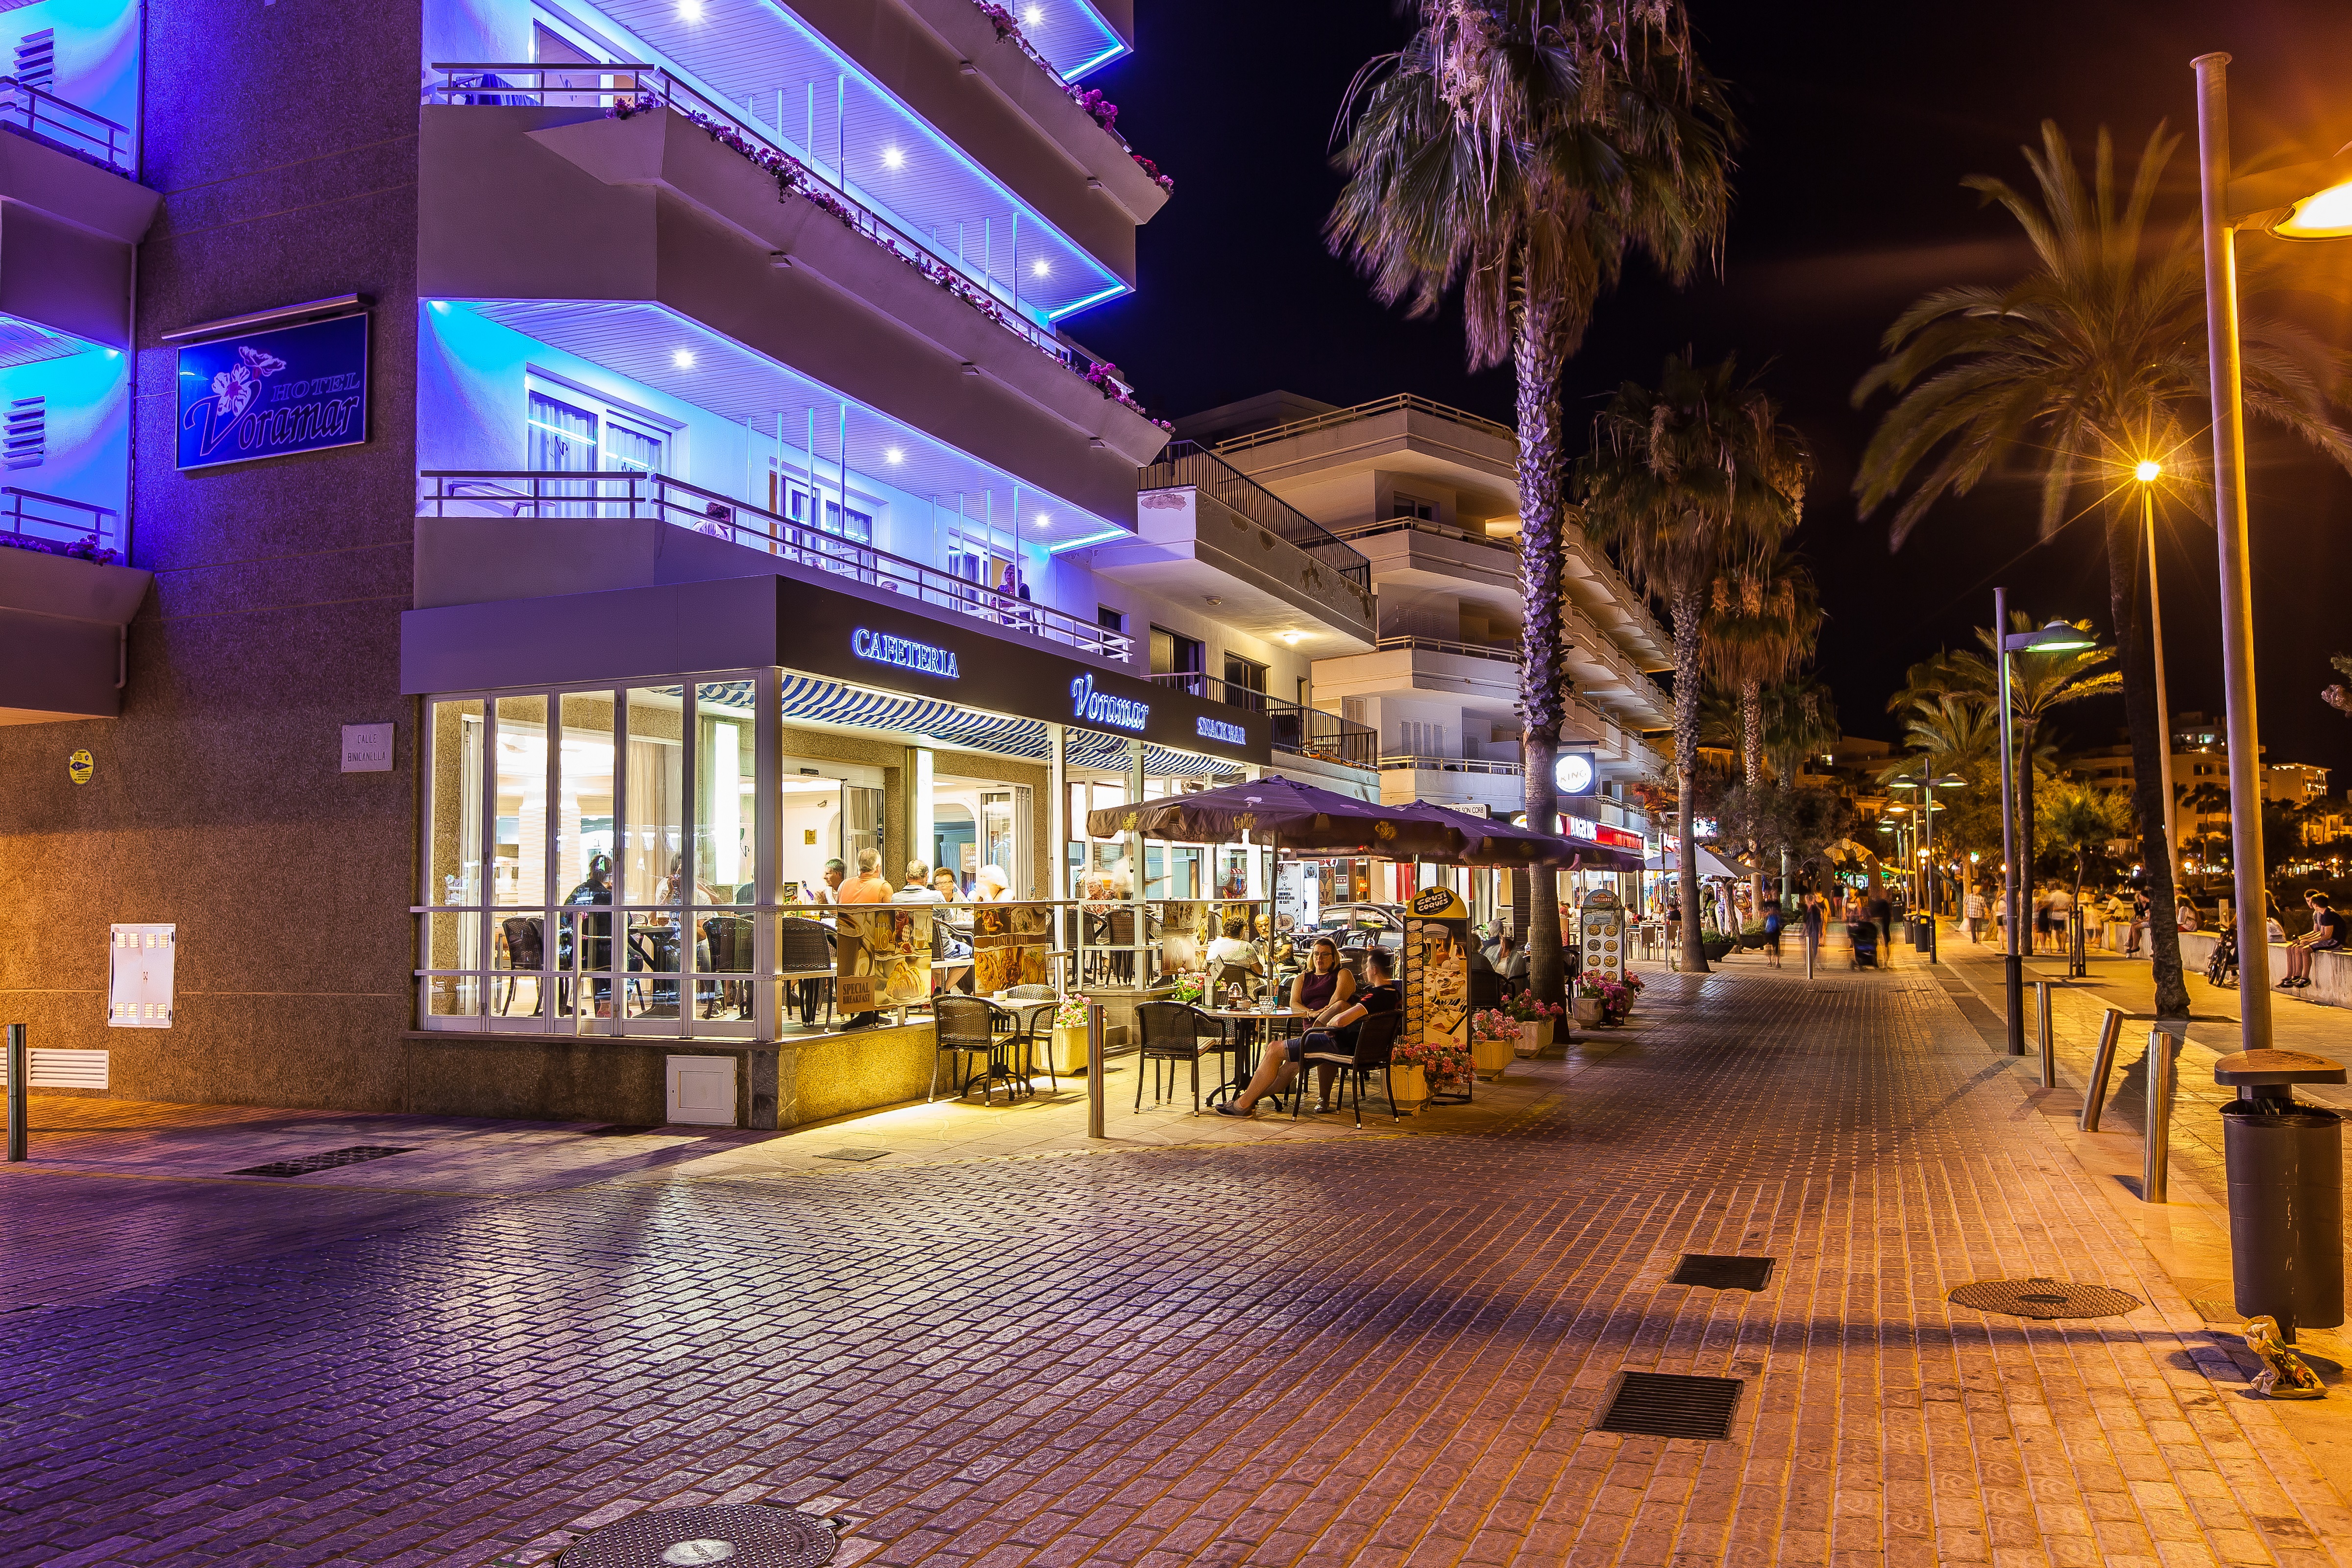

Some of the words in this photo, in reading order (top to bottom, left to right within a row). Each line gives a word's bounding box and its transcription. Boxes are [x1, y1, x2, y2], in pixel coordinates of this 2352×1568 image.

[271, 372, 360, 402] HOTEL
[183, 379, 360, 456] Voramar
[855, 629, 960, 678] CAFETERIA
[1071, 674, 1150, 730] Voramar
[1197, 717, 1228, 741] SNACK
[1228, 724, 1246, 745] BAR
[357, 734, 377, 744] CALLE
[347, 751, 386, 762] BINICANELLA
[1418, 898, 1448, 911] COQUES
[993, 934, 1013, 947] LUNCH
[1014, 934, 1029, 946] TIME
[843, 982, 870, 995] SPECIAL
[842, 993, 870, 1004] BREAKFAST
